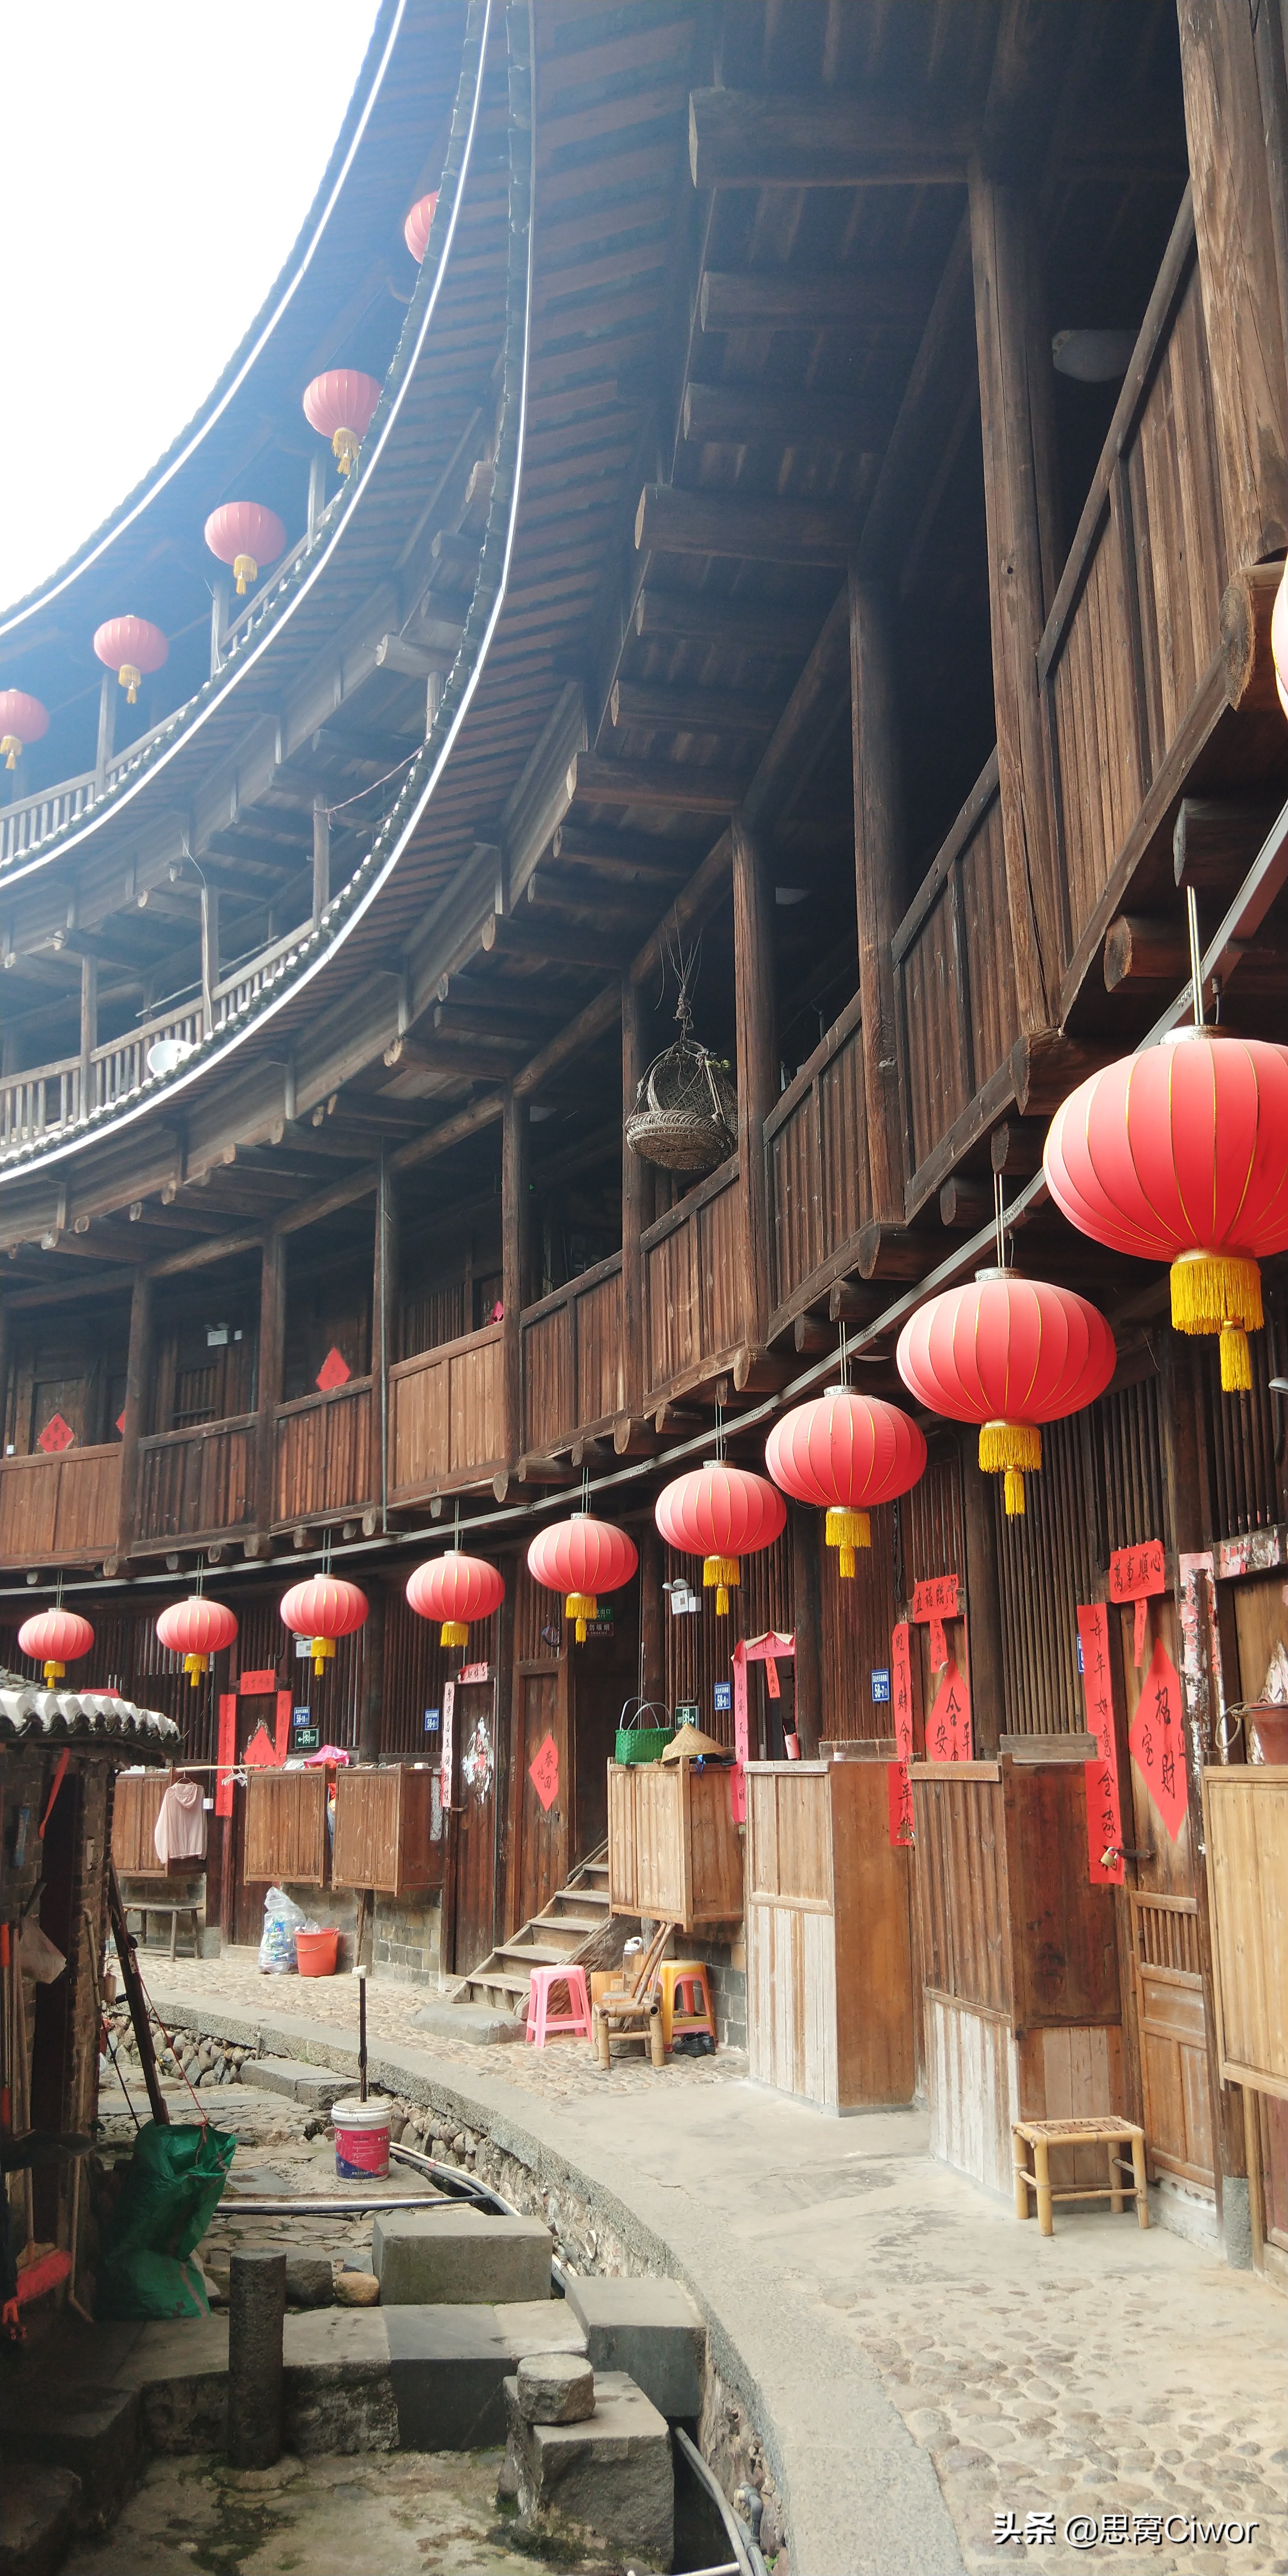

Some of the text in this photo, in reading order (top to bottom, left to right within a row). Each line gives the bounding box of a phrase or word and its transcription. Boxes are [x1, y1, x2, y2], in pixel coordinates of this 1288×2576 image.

[1114, 1550, 1161, 1593] 萬事順心
[874, 1683, 884, 1698] 58-7
[717, 1694, 727, 1708] 58-8
